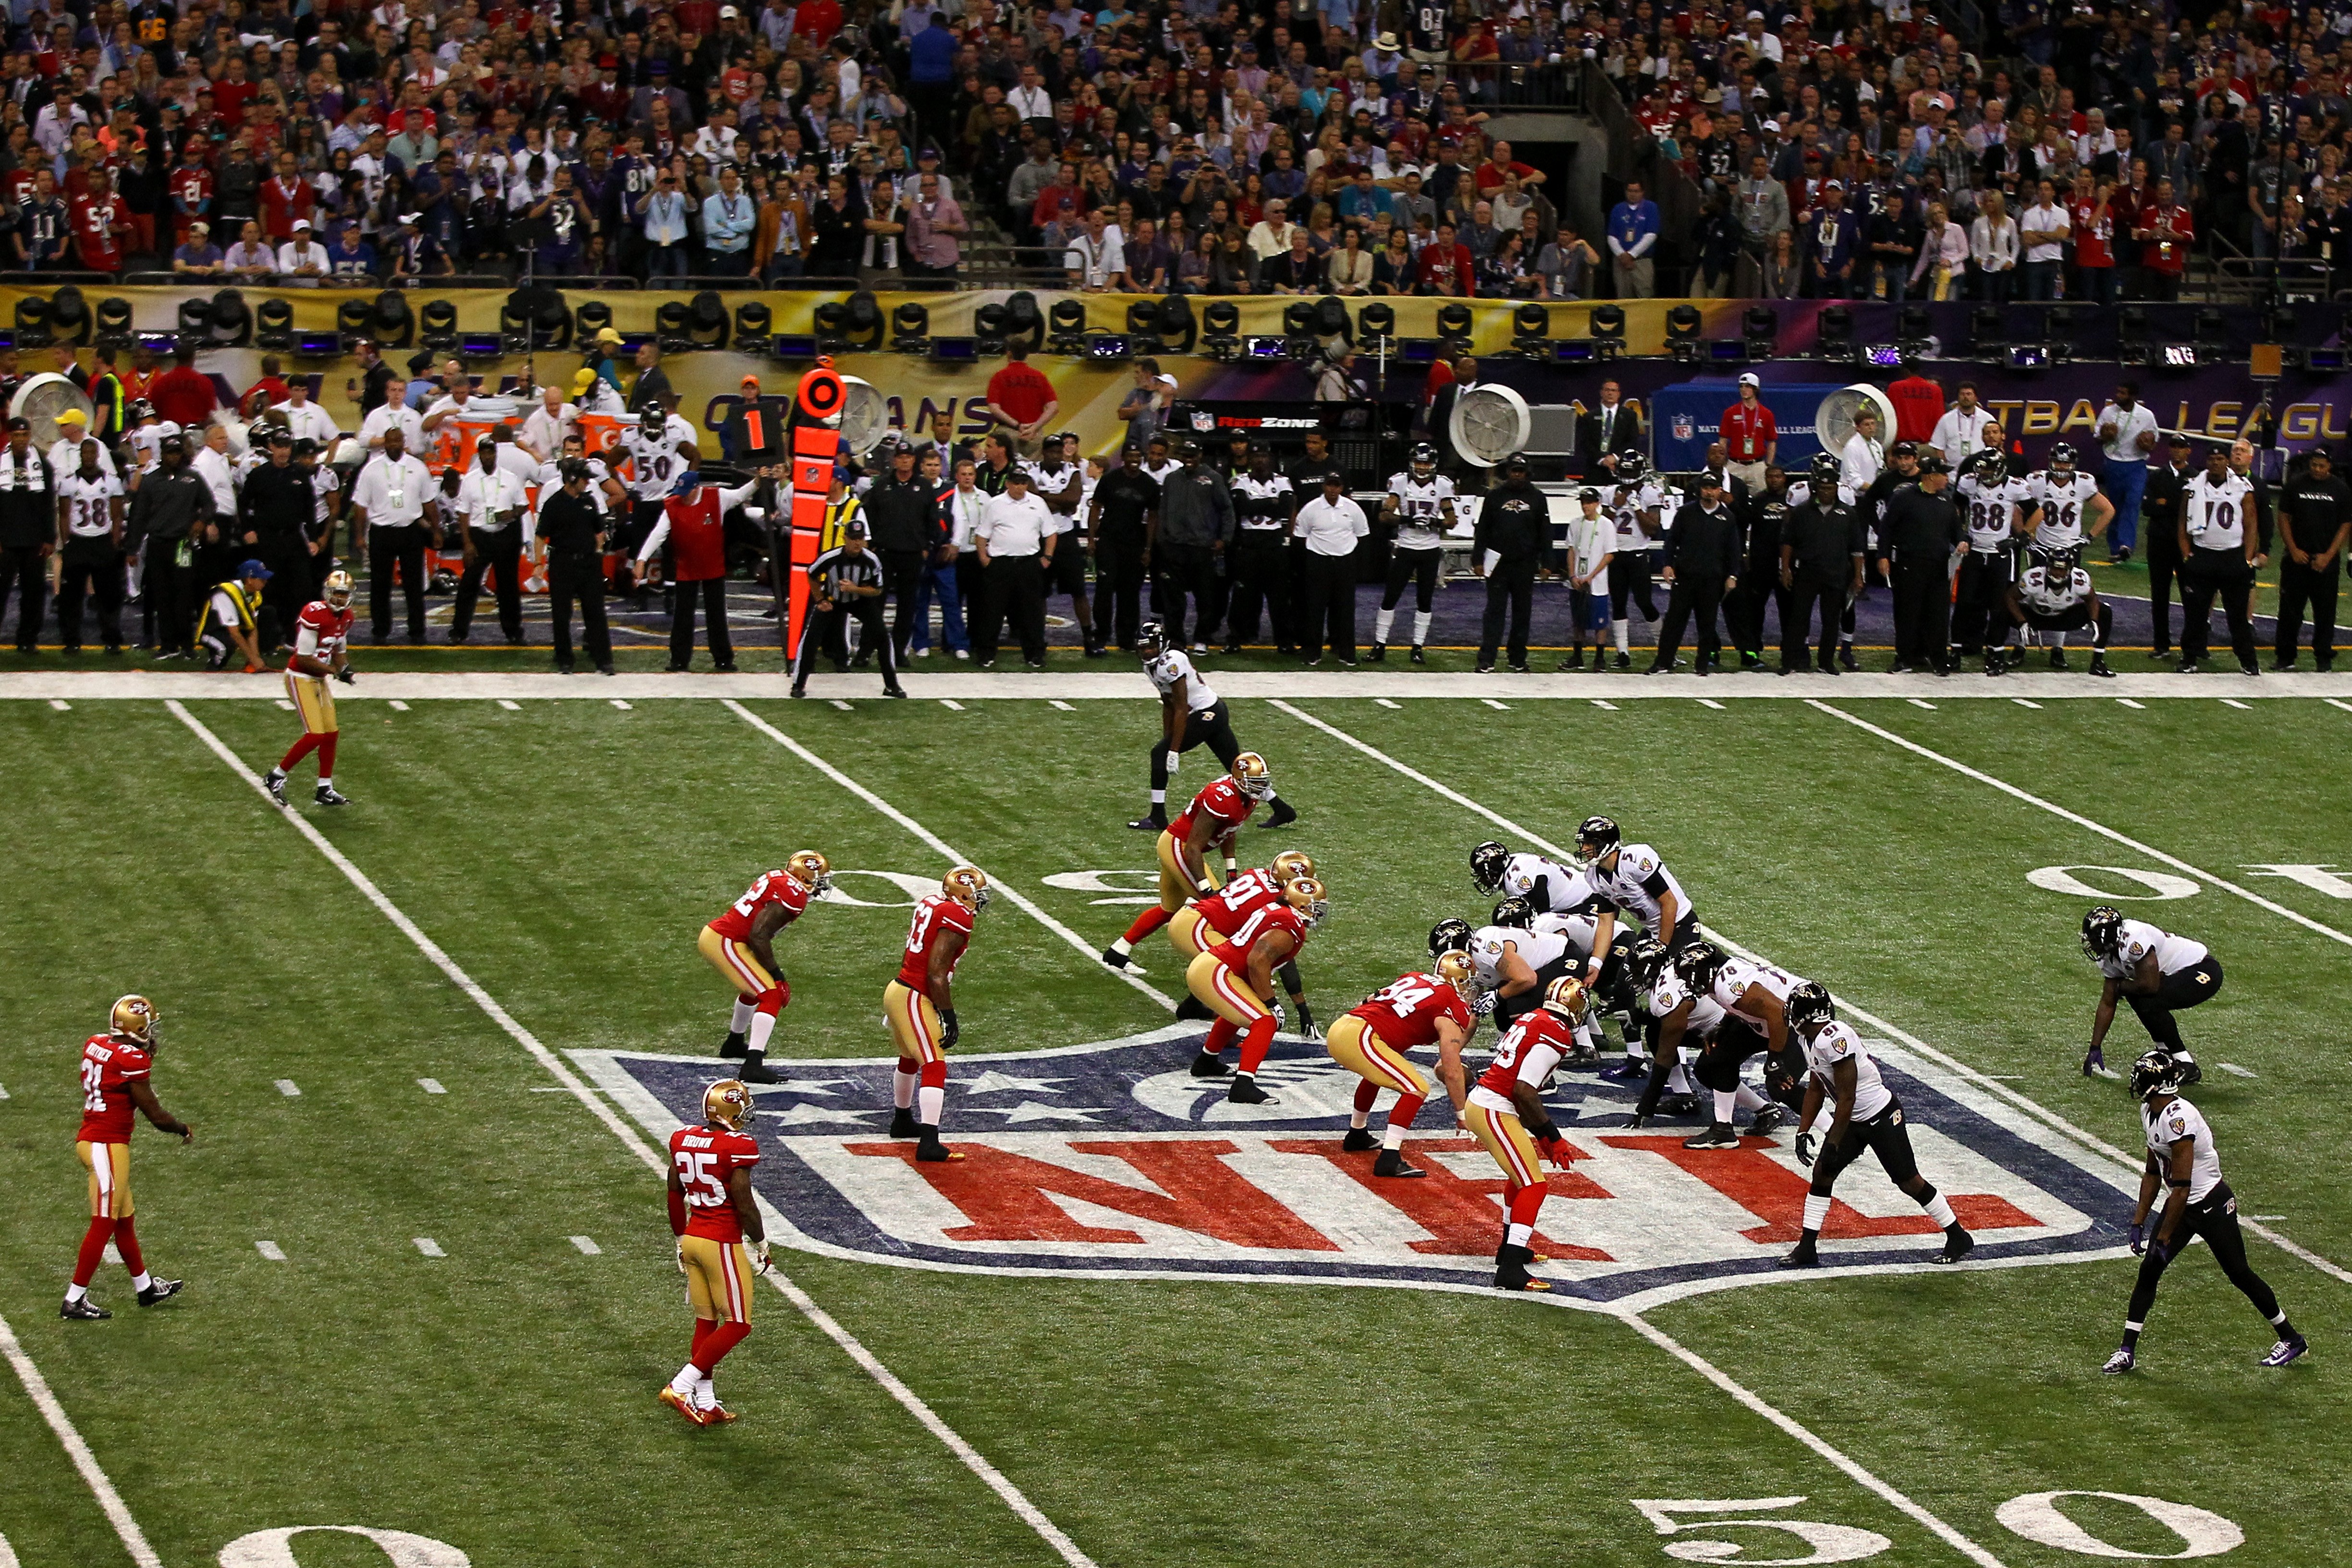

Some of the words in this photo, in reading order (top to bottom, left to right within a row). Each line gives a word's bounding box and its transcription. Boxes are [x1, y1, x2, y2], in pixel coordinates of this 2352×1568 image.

[626, 169, 647, 193] 81
[32, 213, 55, 239] 11
[744, 410, 765, 450] 1
[2176, 400, 2350, 440] LEAGU
[637, 455, 671, 483] 50
[76, 498, 107, 527] 38
[1462, 505, 1471, 515] G
[1971, 502, 2005, 531] 88
[2043, 500, 2077, 527] 86
[1216, 784, 1233, 797] 55
[1621, 852, 1633, 865] 5
[1219, 873, 1264, 912] 91
[1717, 966, 1738, 983] 78
[1378, 976, 1435, 1019] 94
[1823, 1024, 1839, 1037] 81
[80, 1058, 107, 1113] 31
[2167, 1103, 2181, 1116] 12
[681, 1134, 714, 1149] BROWN
[674, 1151, 727, 1207] 25
[842, 1136, 2048, 1262] NFL
